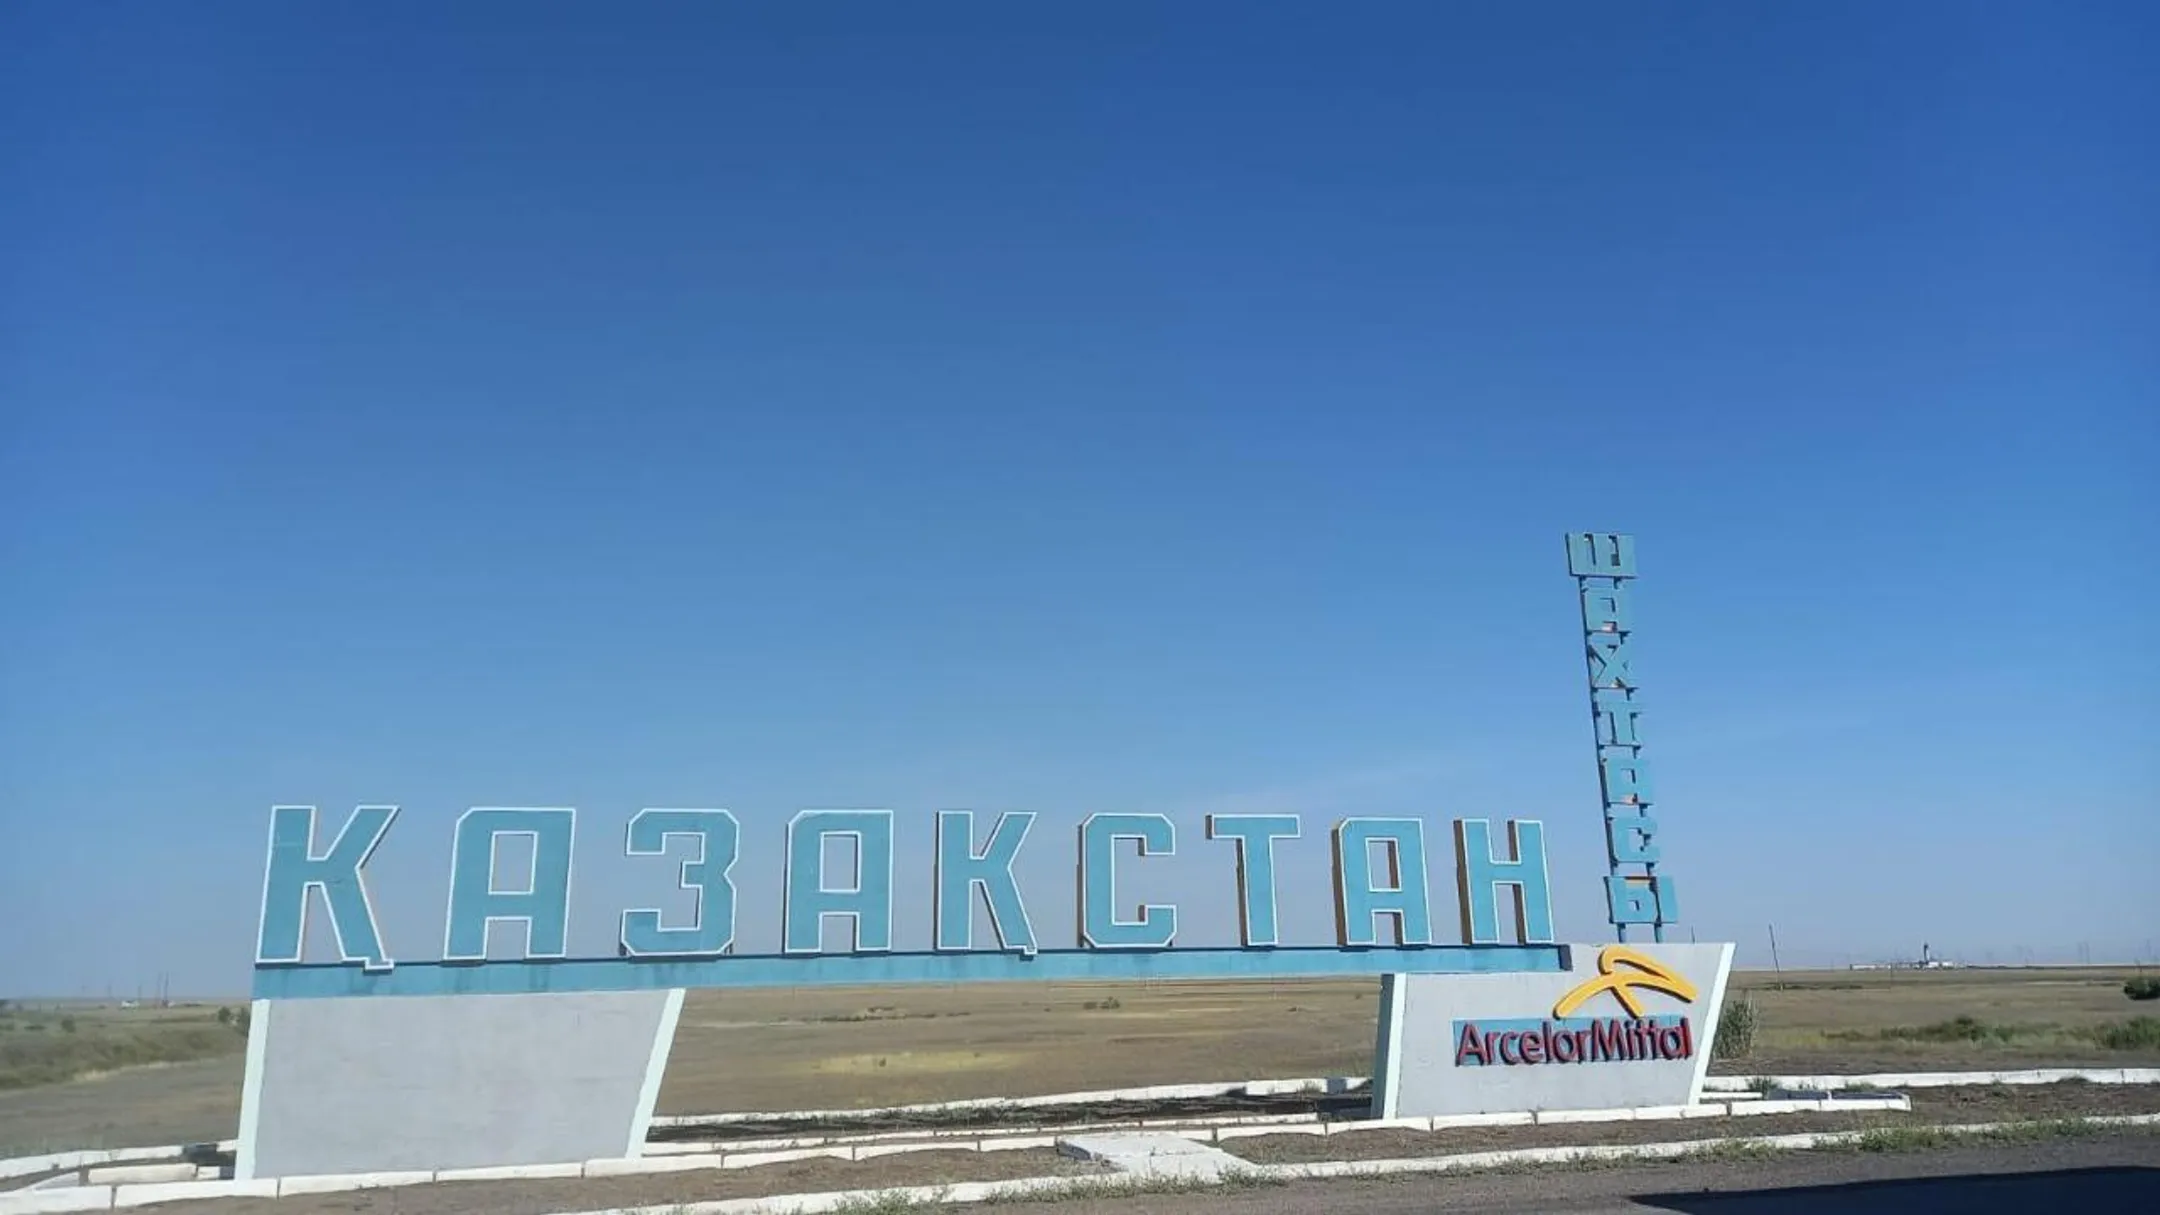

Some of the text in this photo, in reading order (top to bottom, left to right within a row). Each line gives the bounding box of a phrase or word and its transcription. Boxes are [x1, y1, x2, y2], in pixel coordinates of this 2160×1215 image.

[1566, 532, 1677, 924] ШАХТАСЫ
[255, 804, 1554, 971] ҚАЗАҚСТАН
[1455, 1017, 1692, 1067] ArcelorMittal
